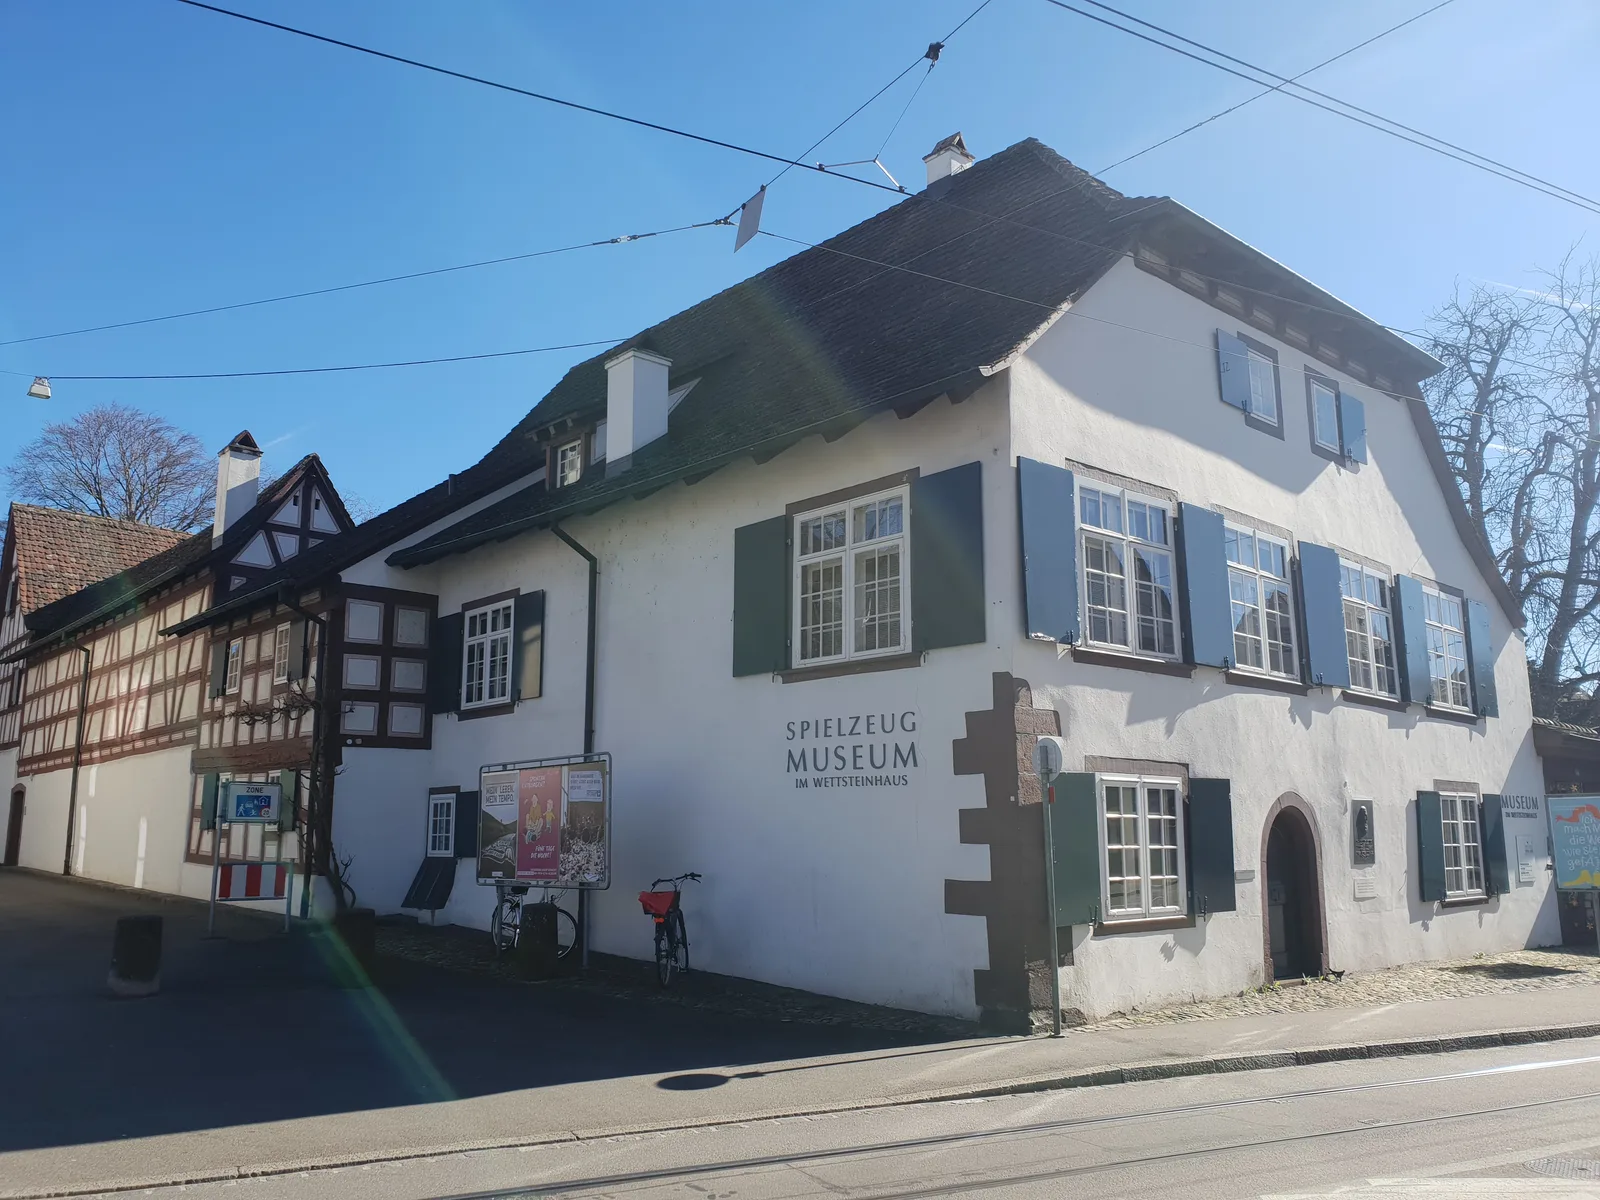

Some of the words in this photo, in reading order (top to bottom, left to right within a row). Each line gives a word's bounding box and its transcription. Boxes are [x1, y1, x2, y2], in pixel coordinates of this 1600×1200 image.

[786, 711, 916, 741] SPIELZEUG
[786, 741, 918, 773] MUSEUM
[795, 778, 808, 788] IM
[812, 774, 908, 788] WETTSTEINHAUS
[246, 786, 264, 794] ZONE
[485, 795, 497, 804] MEIN
[1501, 794, 1539, 810] MUSEUM
[1563, 823, 1592, 834] mach
[1569, 834, 1585, 845] die
[1563, 848, 1581, 857] wie
